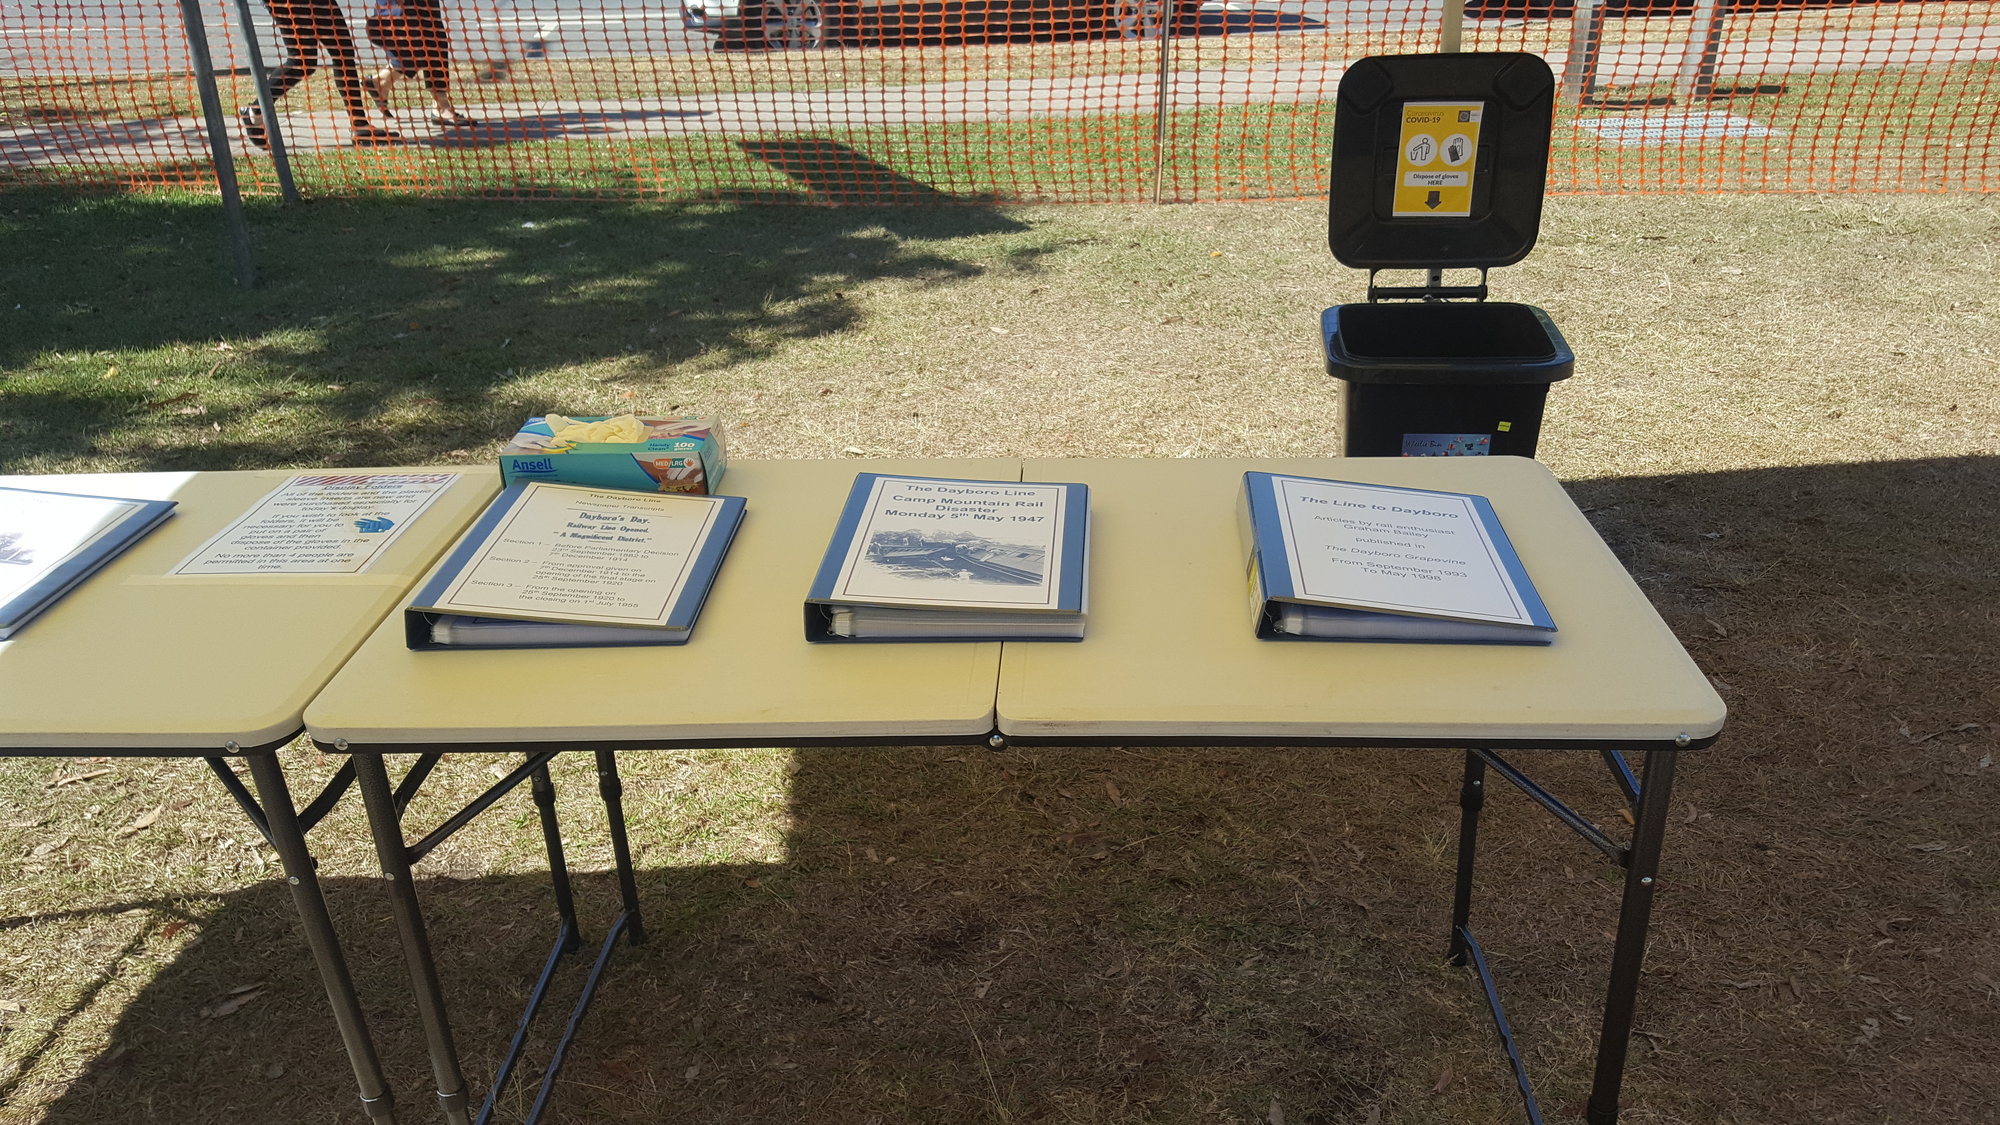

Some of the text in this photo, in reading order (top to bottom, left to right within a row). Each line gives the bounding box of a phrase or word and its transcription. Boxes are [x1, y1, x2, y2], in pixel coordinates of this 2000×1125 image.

[1406, 116, 1441, 124] COVID-19
[512, 458, 553, 470] Ansell
[937, 486, 1000, 496] Dayboro
[575, 500, 620, 508] Newspaper
[892, 495, 936, 504] Camp
[940, 498, 1010, 507] Mountain
[935, 505, 998, 513] Disaster
[1300, 496, 1329, 505] The
[1332, 500, 1367, 508] Line
[1391, 506, 1459, 518] Dayboro
[579, 511, 650, 524] Dayboro's Day.
[884, 509, 945, 520] Monday
[973, 513, 1005, 522] May
[566, 522, 597, 530] Railway
[1313, 515, 1356, 524] Articles
[1395, 525, 1456, 535] enthusiast
[1342, 524, 1429, 538] Graham Bailey
[569, 532, 614, 541] Magnificent
[503, 538, 535, 546] Section
[584, 546, 641, 554] Parliamentary
[1355, 537, 1411, 547] published
[561, 552, 605, 560] December
[570, 549, 616, 557] September
[1350, 547, 1401, 558] Dayboro
[1404, 553, 1467, 565] Grapevine
[551, 566, 596, 574] December
[1331, 557, 1468, 578] From September 1993
[551, 576, 600, 584] September
[1380, 569, 1408, 578] May
[1411, 573, 1442, 581] 1998
[541, 590, 591, 599] September
[567, 588, 603, 596] opening
[535, 596, 567, 604] closing
